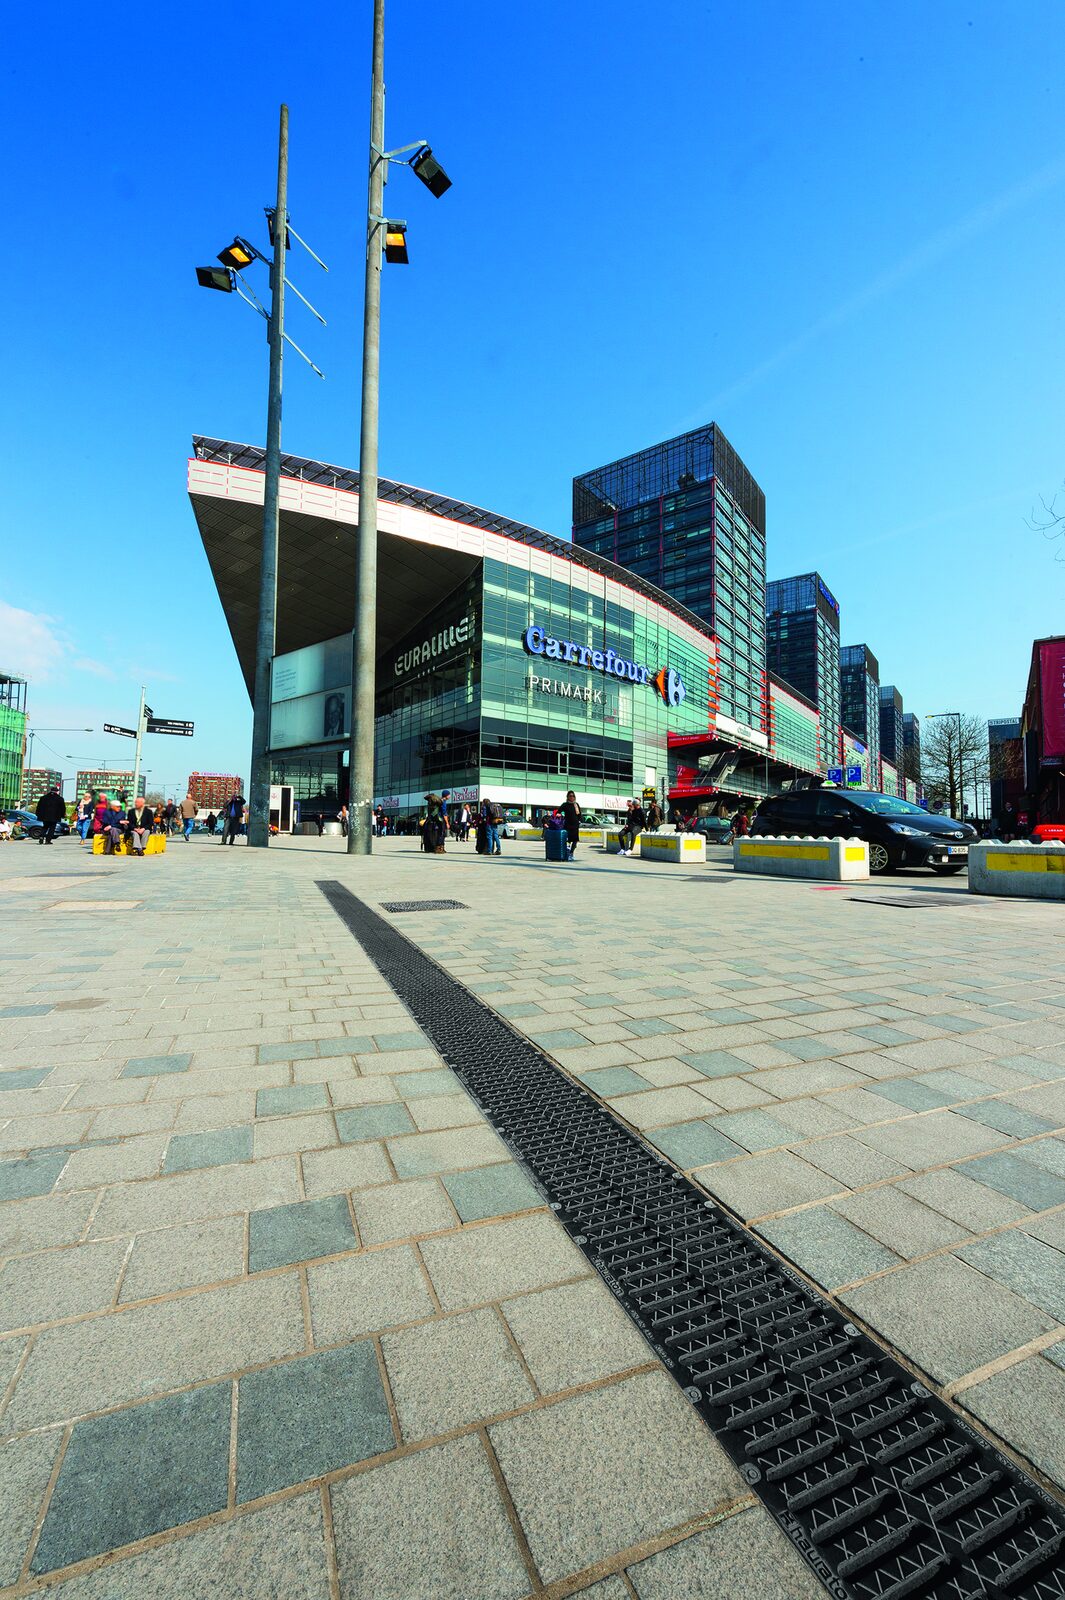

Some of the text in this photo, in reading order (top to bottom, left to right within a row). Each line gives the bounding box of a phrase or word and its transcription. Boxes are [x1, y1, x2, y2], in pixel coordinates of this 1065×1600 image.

[394, 617, 468, 676] EURALILLE
[524, 625, 651, 685] Carrefour
[529, 675, 602, 704] PRIMARK
[848, 768, 856, 778] P
